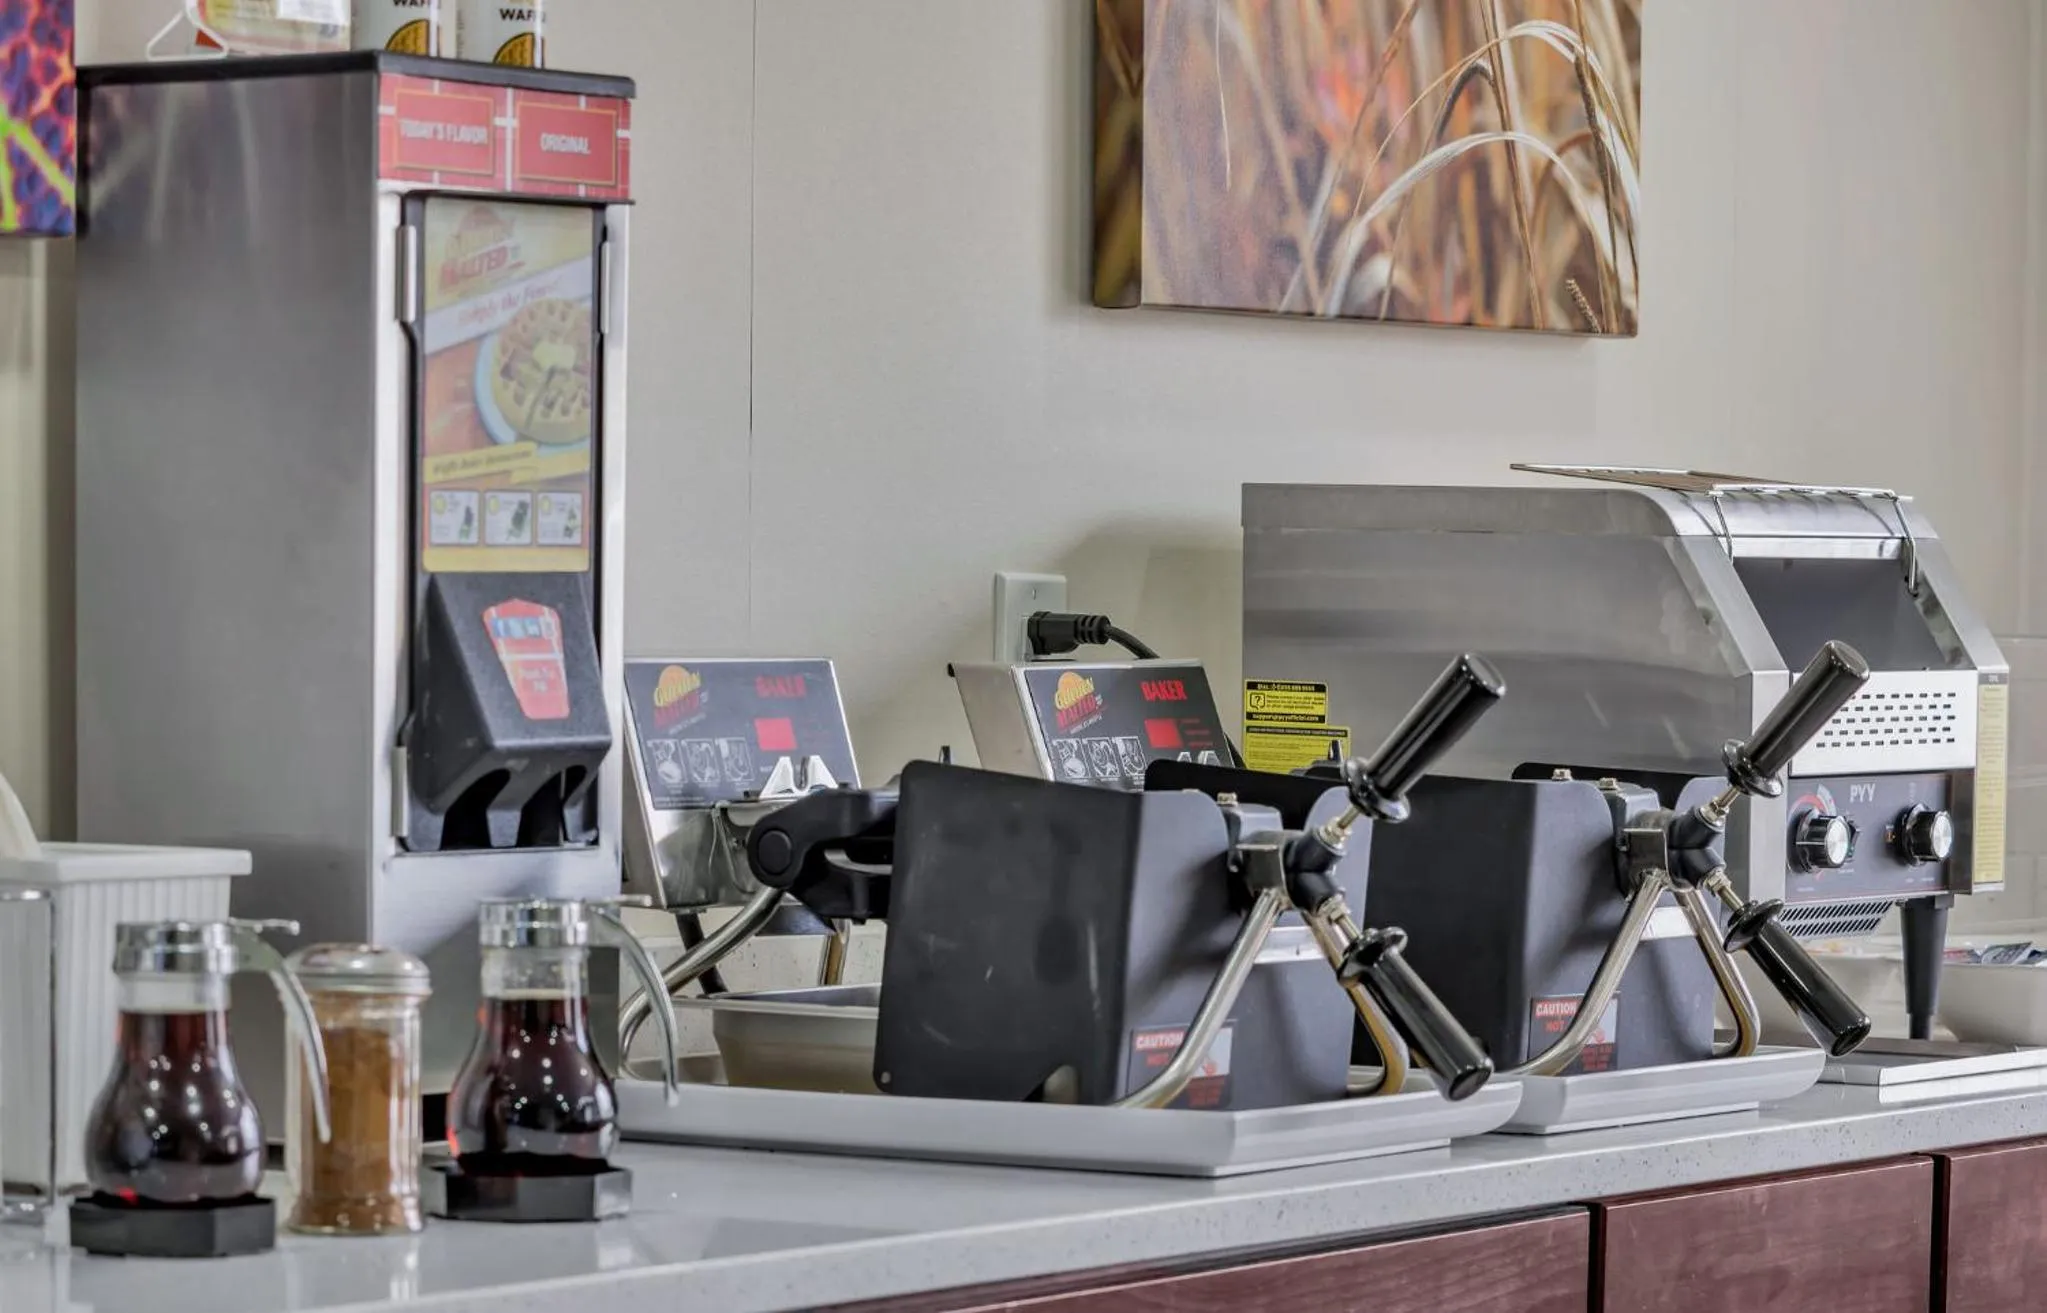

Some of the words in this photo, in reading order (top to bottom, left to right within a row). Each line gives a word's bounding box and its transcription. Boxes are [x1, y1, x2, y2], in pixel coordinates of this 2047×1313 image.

[446, 124, 488, 145] FLAVOR
[540, 133, 591, 154] ORIGINAL
[1140, 679, 1188, 702] BAKER
[1849, 782, 1876, 803] PYY
[1536, 1001, 1578, 1017] CAUTION
